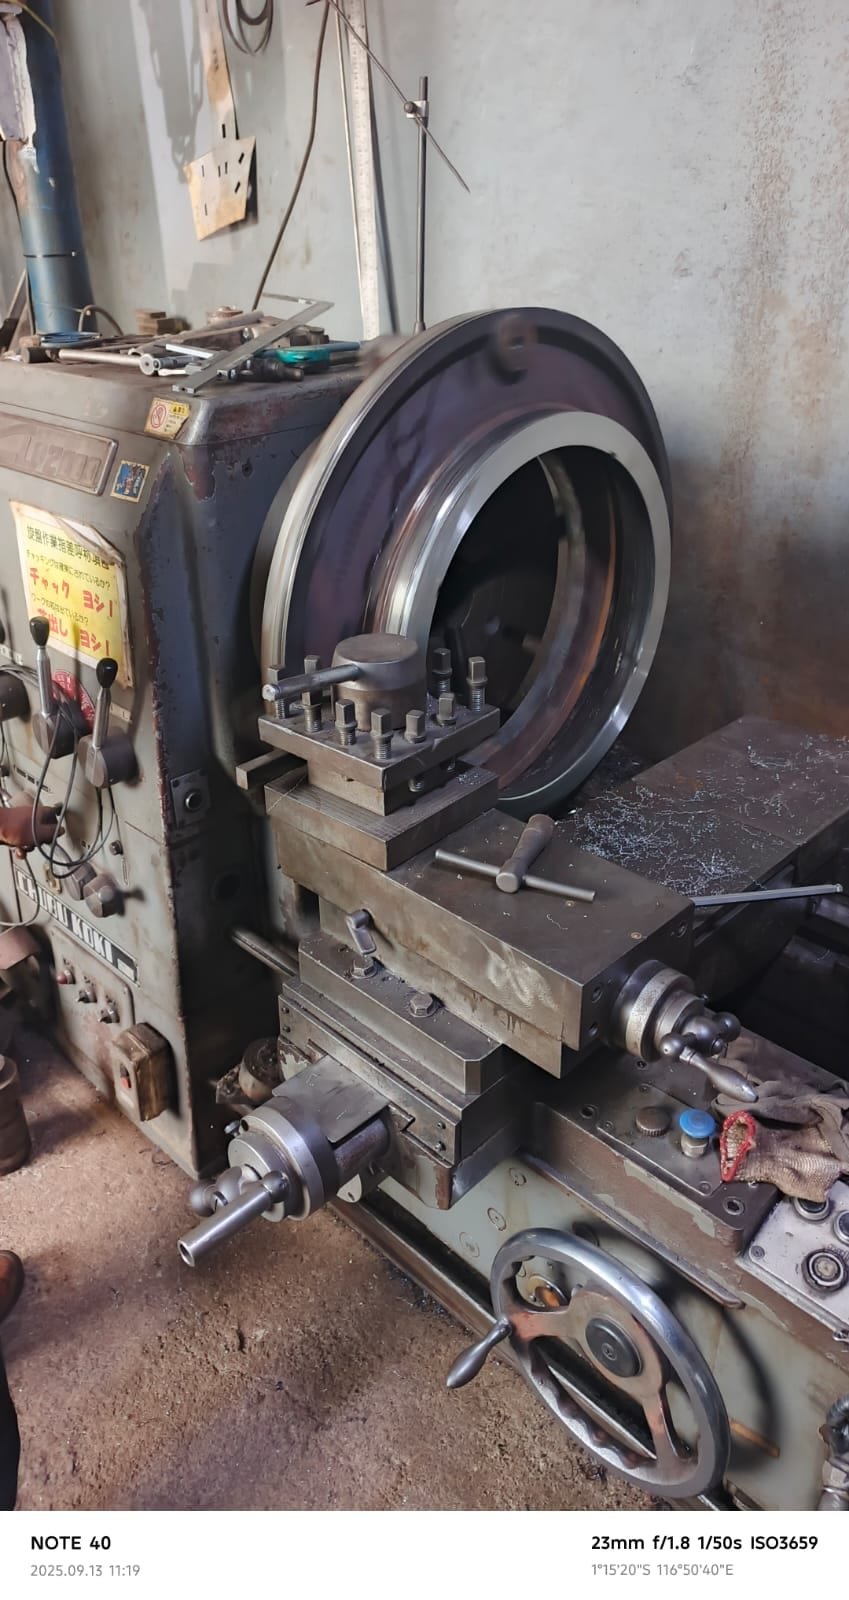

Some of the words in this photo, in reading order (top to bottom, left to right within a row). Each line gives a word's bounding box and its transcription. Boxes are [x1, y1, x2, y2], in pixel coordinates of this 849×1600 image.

[30, 567, 70, 599] チャック
[71, 912, 113, 964] KOKI
